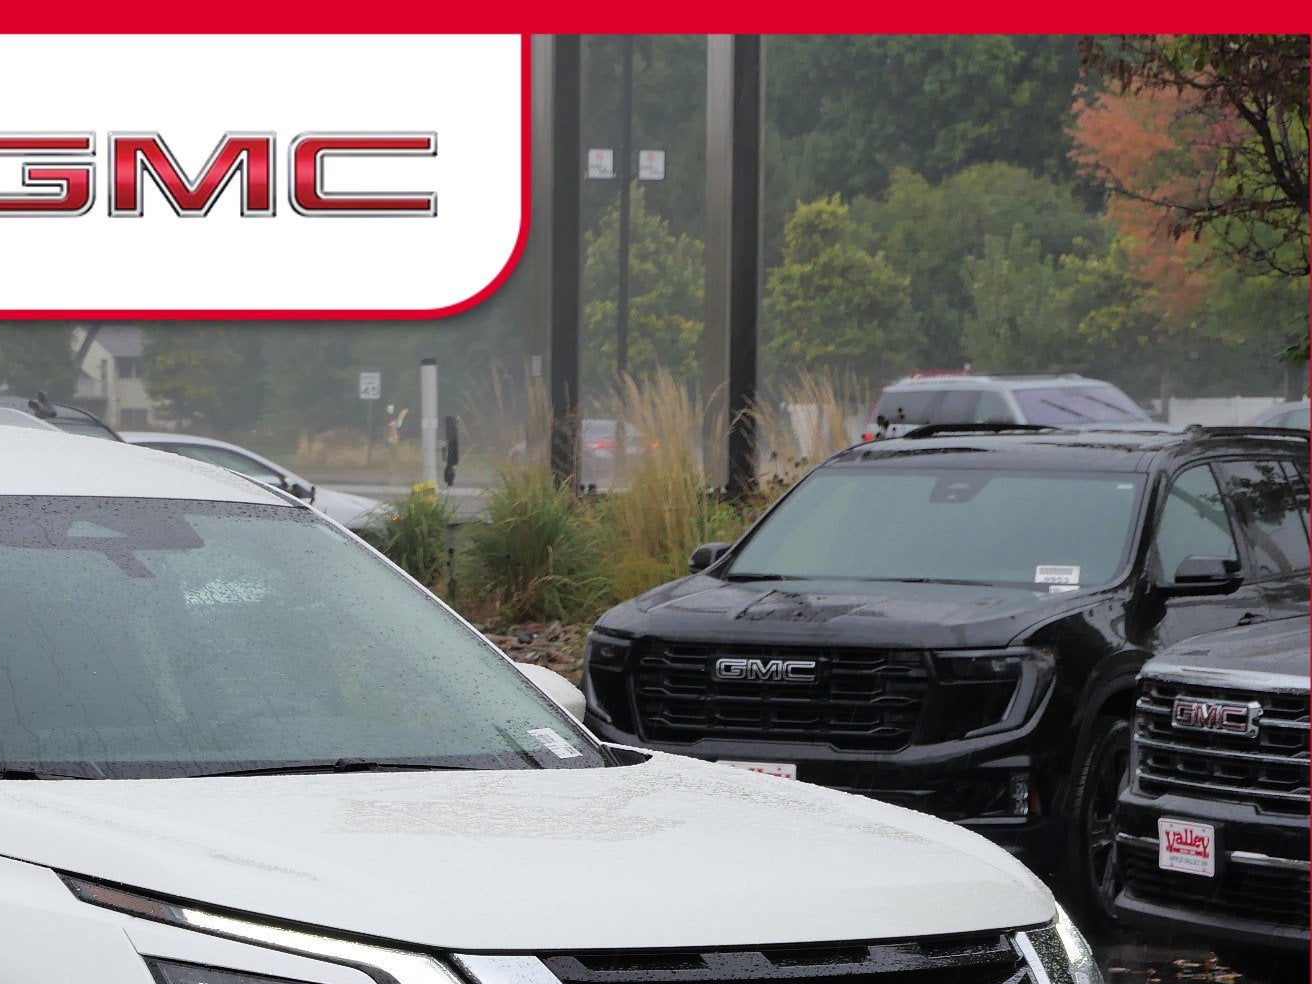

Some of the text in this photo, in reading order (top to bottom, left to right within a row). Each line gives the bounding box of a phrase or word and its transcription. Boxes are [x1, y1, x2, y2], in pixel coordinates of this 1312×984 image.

[716, 659, 816, 681] GMC
[1174, 701, 1248, 733] GMC
[1165, 829, 1209, 859] Valley
